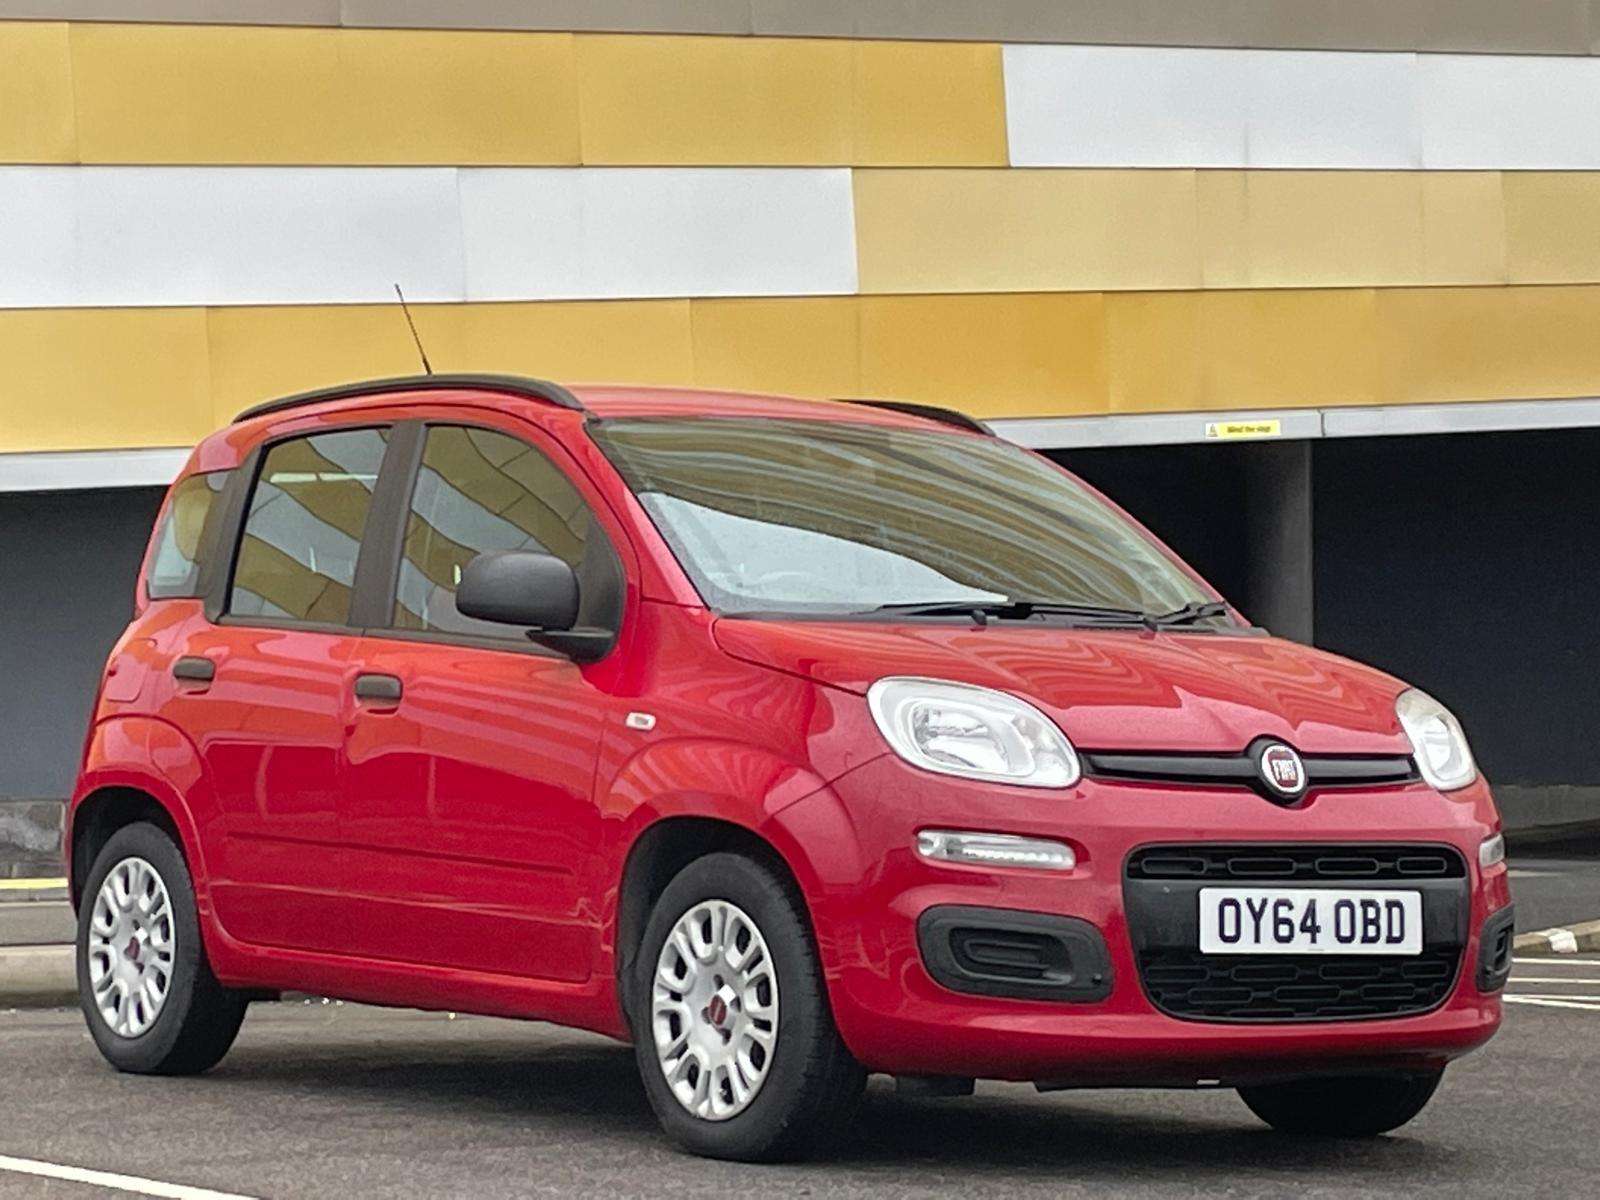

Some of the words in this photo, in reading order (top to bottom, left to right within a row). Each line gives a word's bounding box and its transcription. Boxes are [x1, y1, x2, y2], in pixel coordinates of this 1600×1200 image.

[1271, 759, 1298, 781] FIAT
[1218, 897, 1321, 944] OY64
[1334, 898, 1405, 944] OBD
